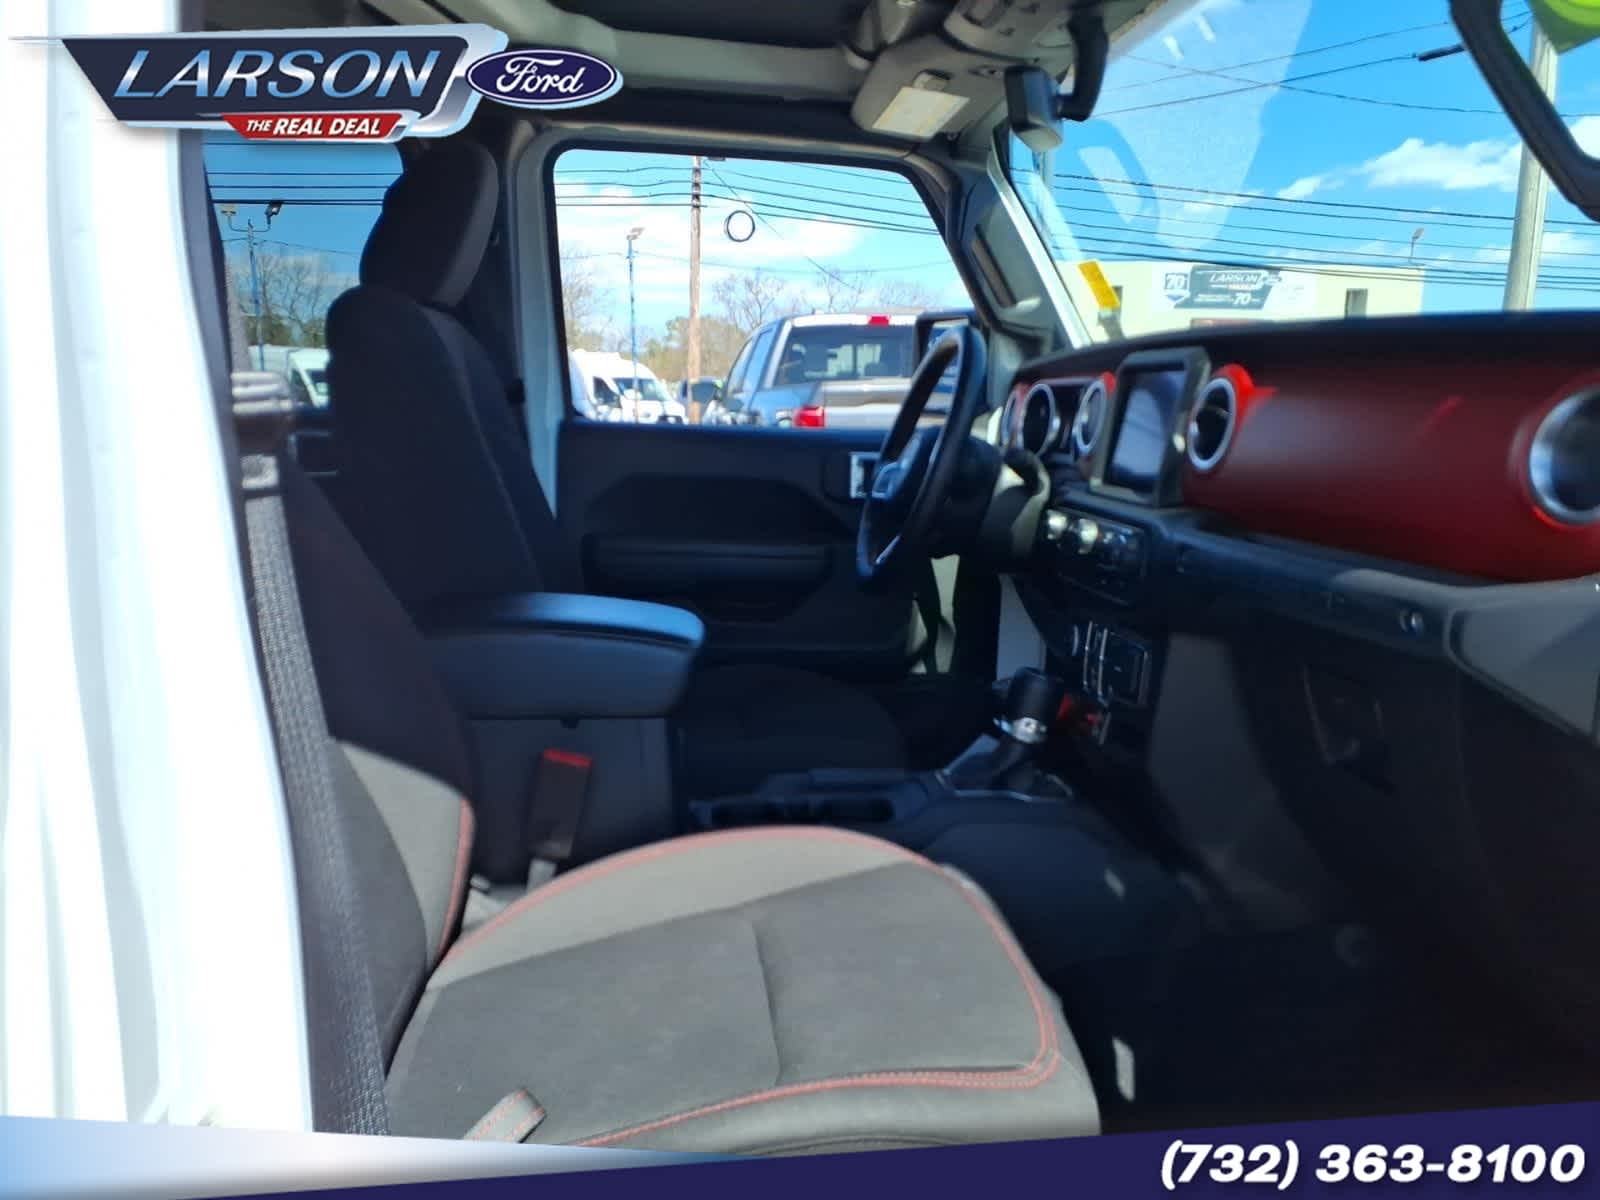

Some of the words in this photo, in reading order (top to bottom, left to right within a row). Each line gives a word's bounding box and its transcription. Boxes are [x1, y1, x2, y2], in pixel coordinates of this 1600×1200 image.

[1166, 274, 1186, 290] 70
[1209, 272, 1258, 284] LARSON
[1232, 293, 1251, 305] 70
